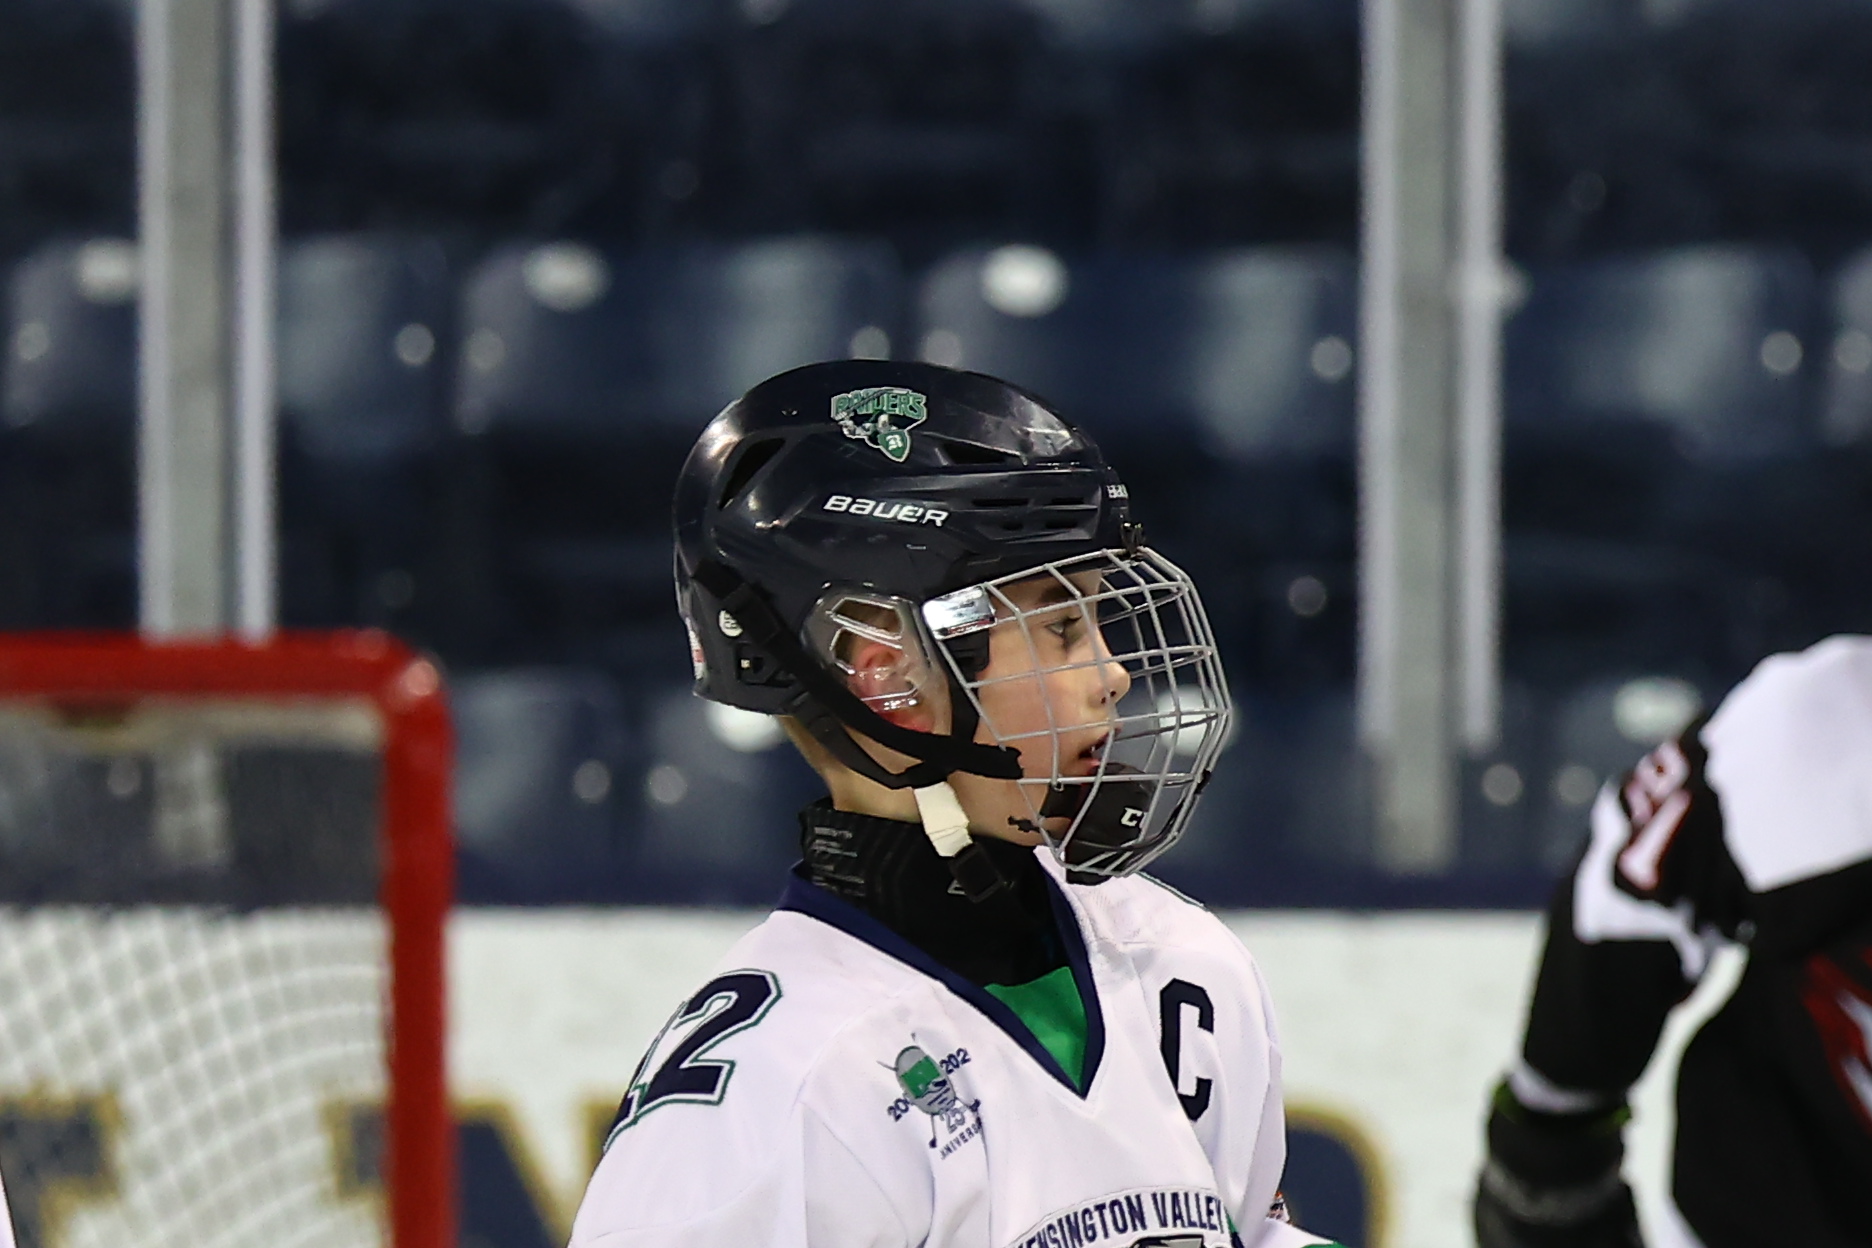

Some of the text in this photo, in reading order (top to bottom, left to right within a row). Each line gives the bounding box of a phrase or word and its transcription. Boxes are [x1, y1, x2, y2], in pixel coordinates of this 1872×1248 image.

[823, 495, 949, 527] BAUER
[602, 968, 783, 1156] 2
[1158, 977, 1214, 1122] C
[1152, 1191, 1226, 1234] VALLEY
